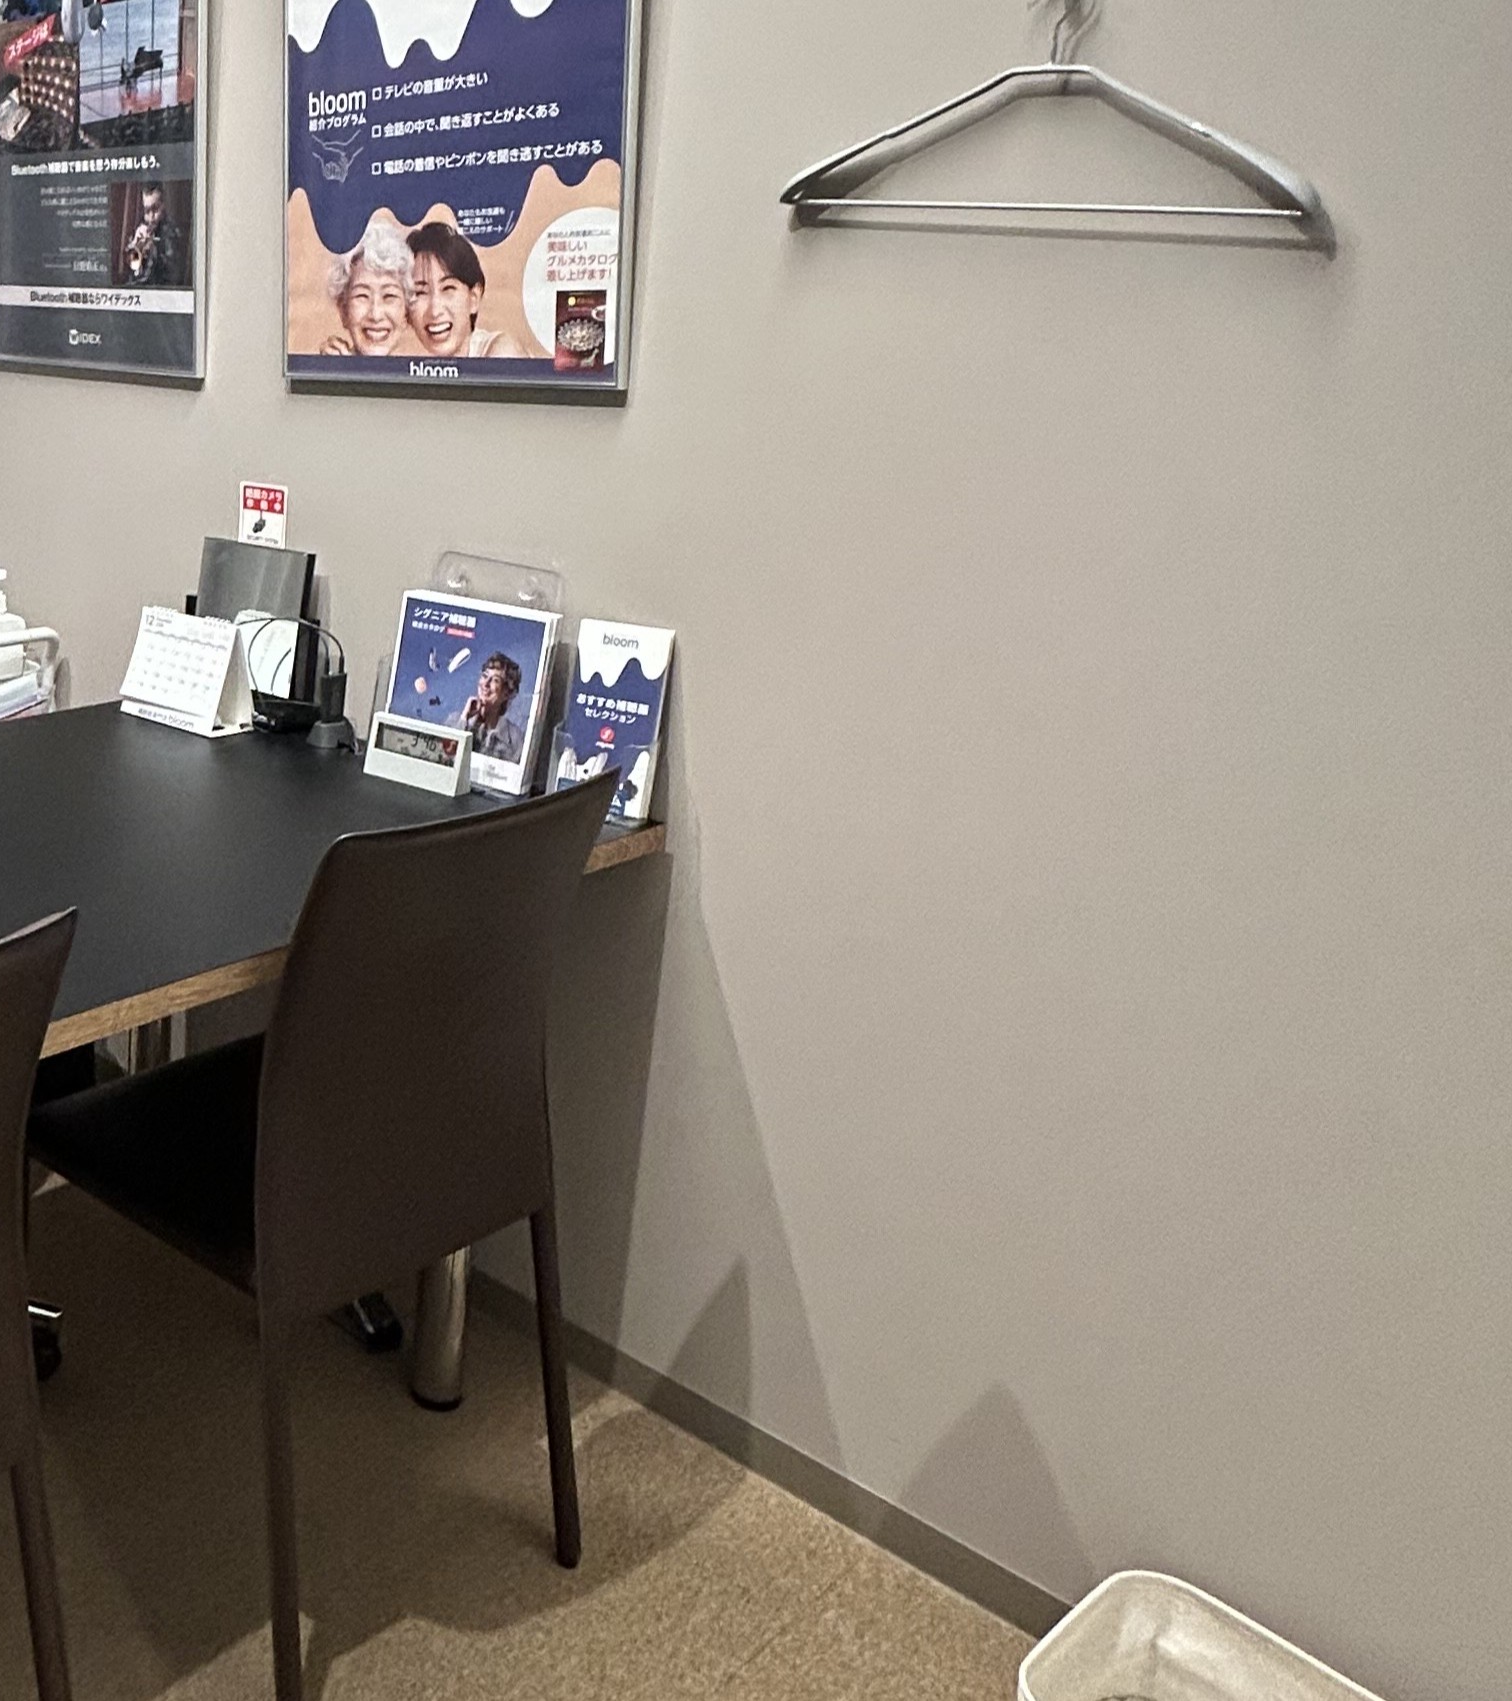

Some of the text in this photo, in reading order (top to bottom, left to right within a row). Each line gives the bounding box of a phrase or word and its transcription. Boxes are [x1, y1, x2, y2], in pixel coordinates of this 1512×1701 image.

[384, 71, 488, 101] テレビの音量が大きい
[308, 89, 367, 118] bloom
[308, 112, 367, 132] 紹介プログラム
[384, 103, 560, 137] 会話の中で、聞き返すことがよくある
[602, 633, 640, 650] bloom
[584, 707, 637, 725] セレクション
